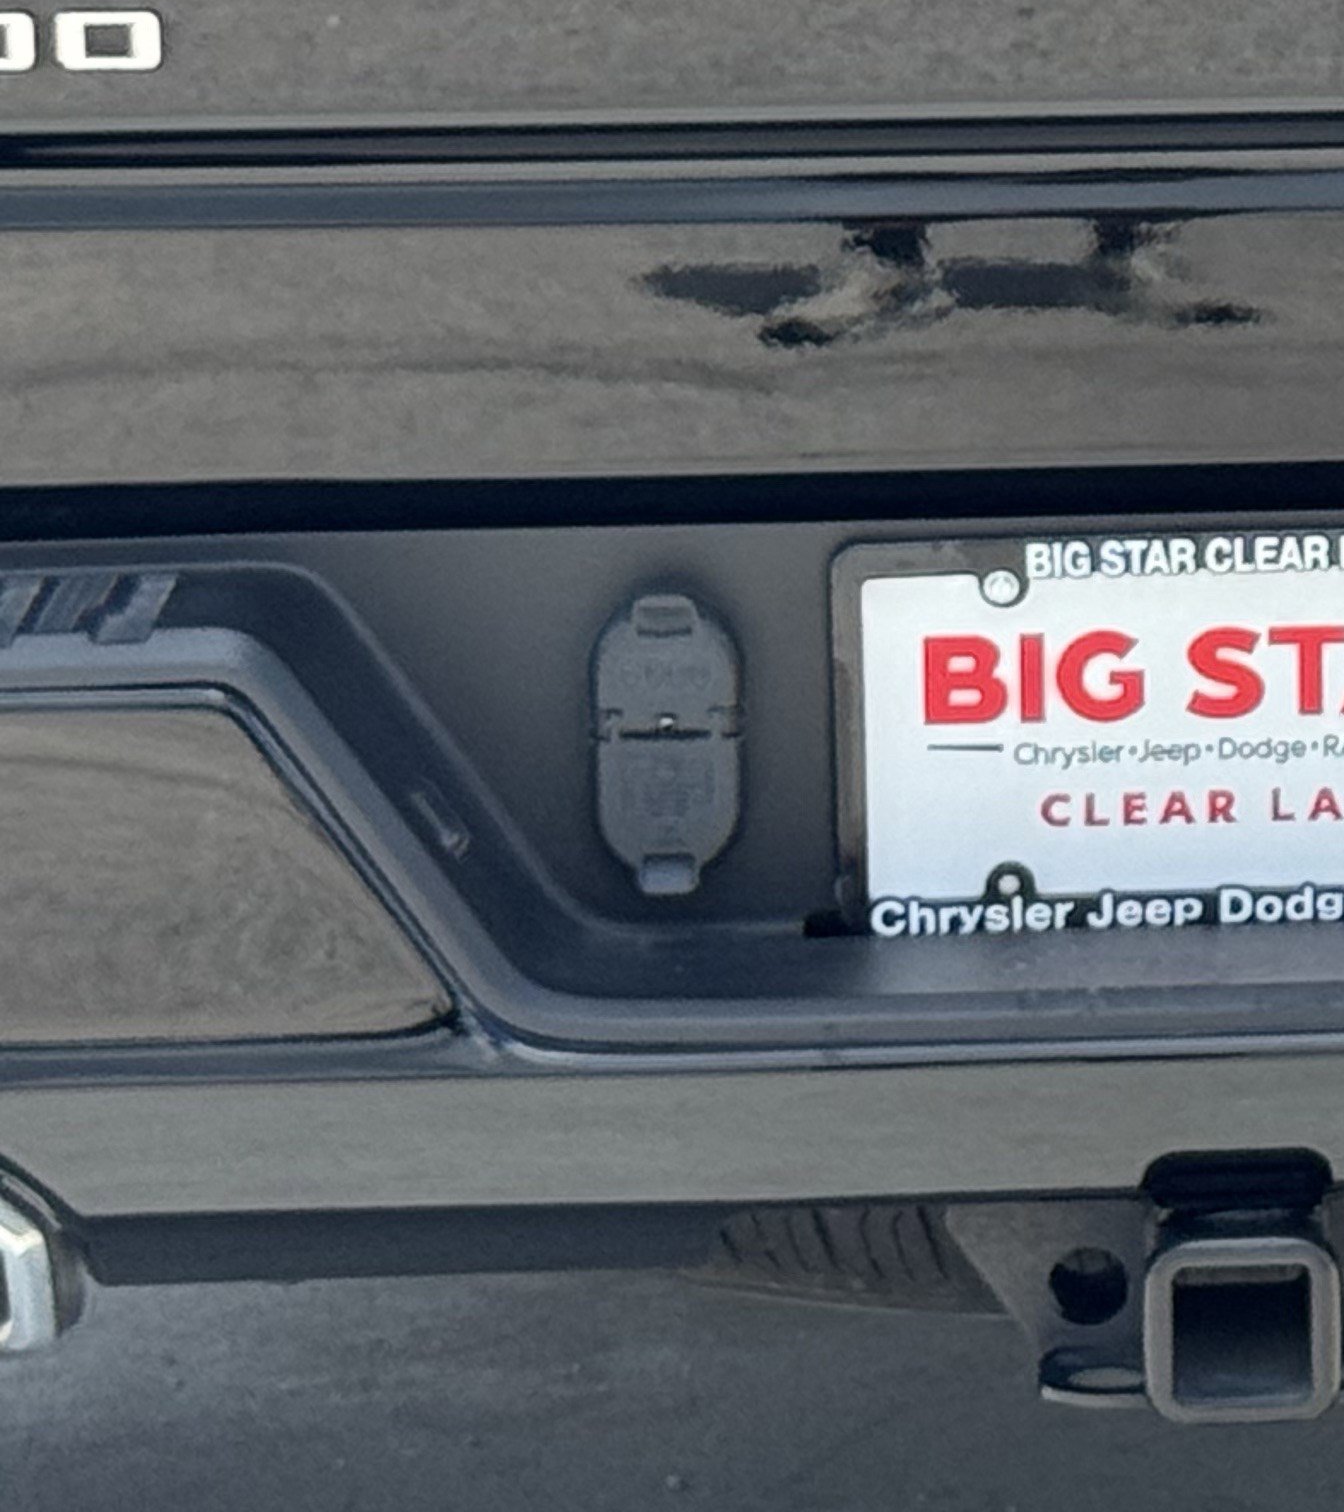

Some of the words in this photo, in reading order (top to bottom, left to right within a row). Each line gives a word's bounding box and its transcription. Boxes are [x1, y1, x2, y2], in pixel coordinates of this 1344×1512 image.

[1025, 541, 1091, 578] BIG
[1099, 538, 1198, 575] STAR
[1204, 535, 1330, 573] CLEAR
[923, 629, 1146, 726] BIG
[1013, 741, 1124, 770] Chrysler
[1138, 739, 1201, 766] Jeep
[1218, 737, 1307, 764] Dodge
[1040, 789, 1237, 827] CLEAR
[869, 894, 1074, 938] Chrysler
[1086, 891, 1203, 930] Jeep
